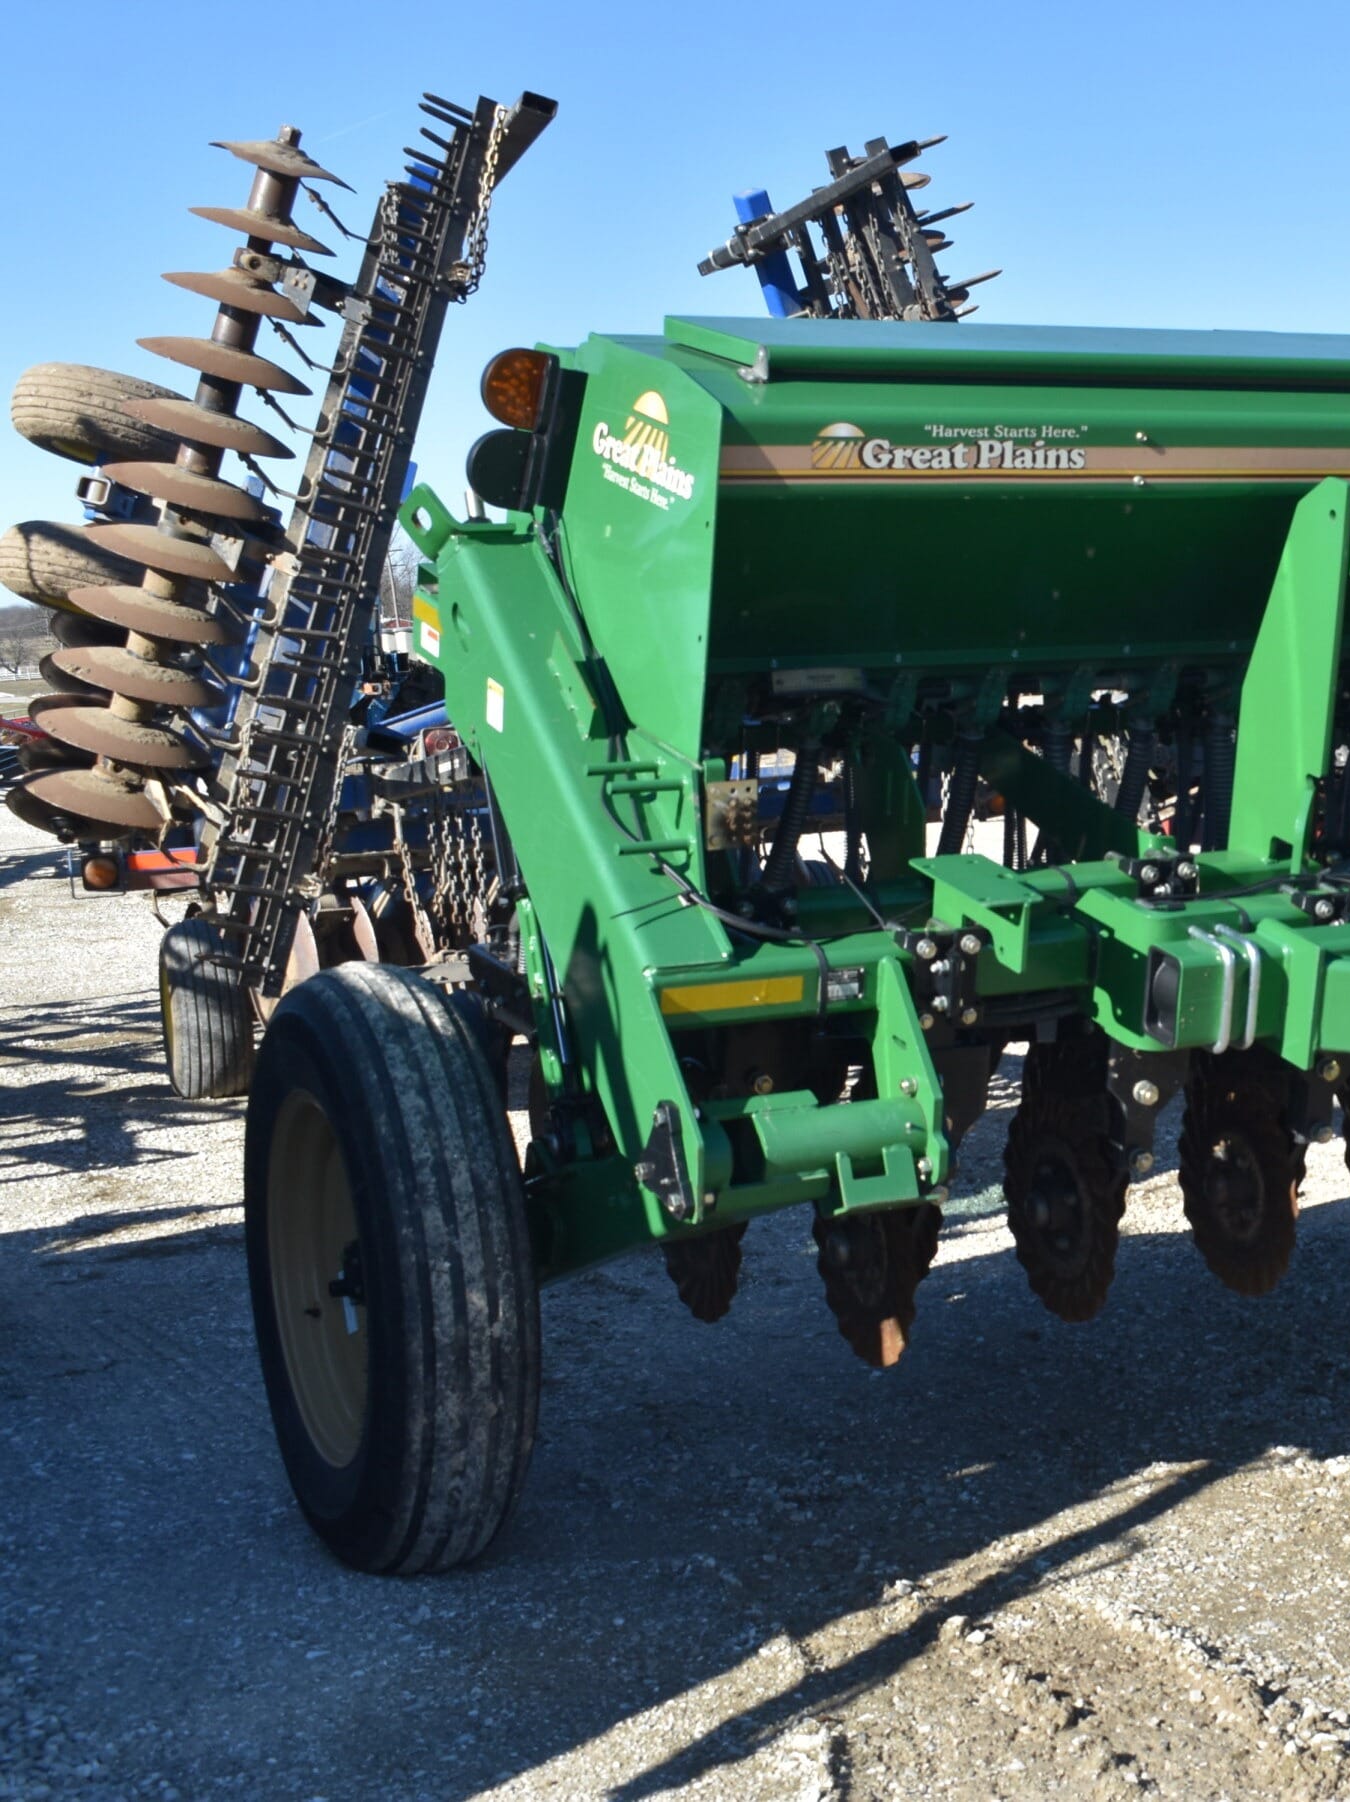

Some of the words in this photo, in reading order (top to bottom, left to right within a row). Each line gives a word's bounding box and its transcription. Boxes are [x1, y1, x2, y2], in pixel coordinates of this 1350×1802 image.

[994, 424, 1037, 438] Starts
[593, 422, 641, 472] Great
[639, 444, 695, 499] Plains
[861, 439, 968, 469] Great
[976, 439, 1086, 469] Plains
